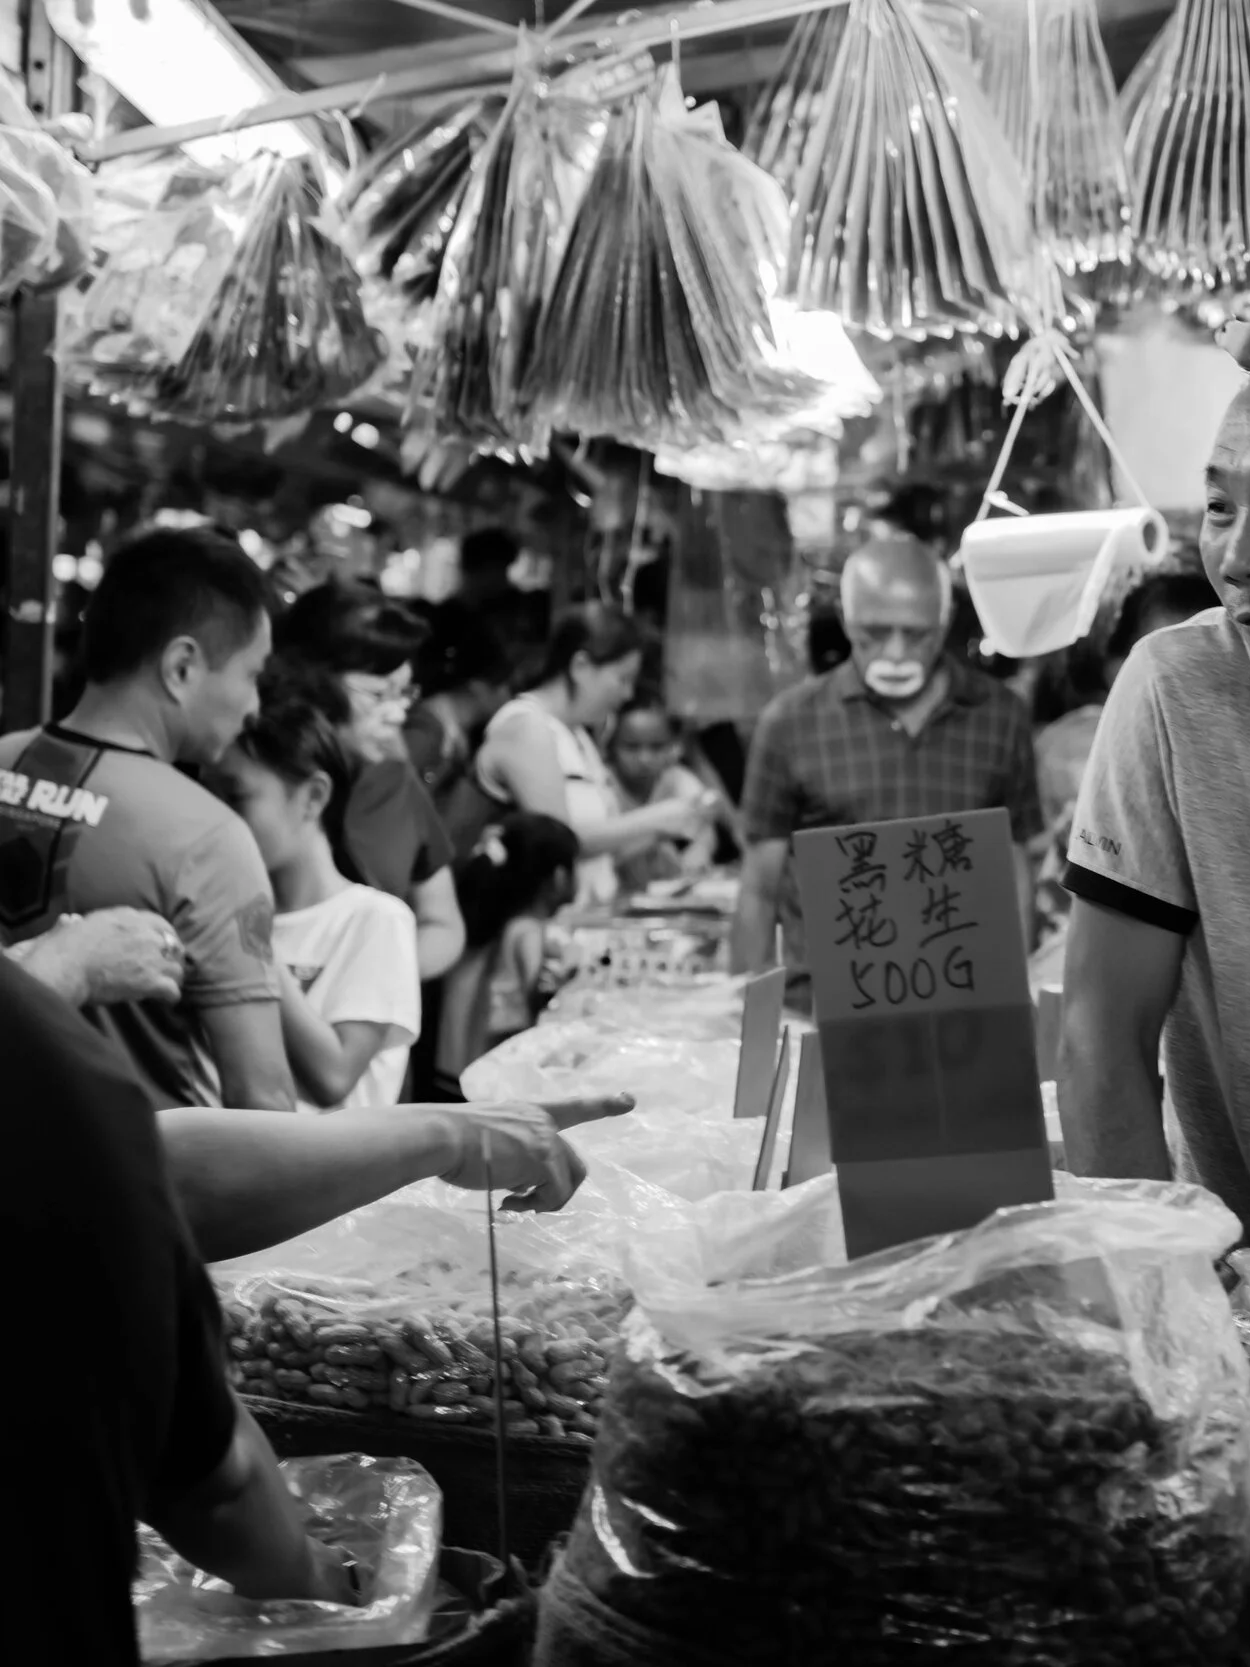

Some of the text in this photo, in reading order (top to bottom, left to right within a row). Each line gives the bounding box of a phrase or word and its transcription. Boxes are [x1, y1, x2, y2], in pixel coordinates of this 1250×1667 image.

[26, 778, 109, 827] RUN
[834, 819, 975, 893] 黑糖
[834, 884, 979, 950] 花生
[850, 946, 976, 1010] 500G
